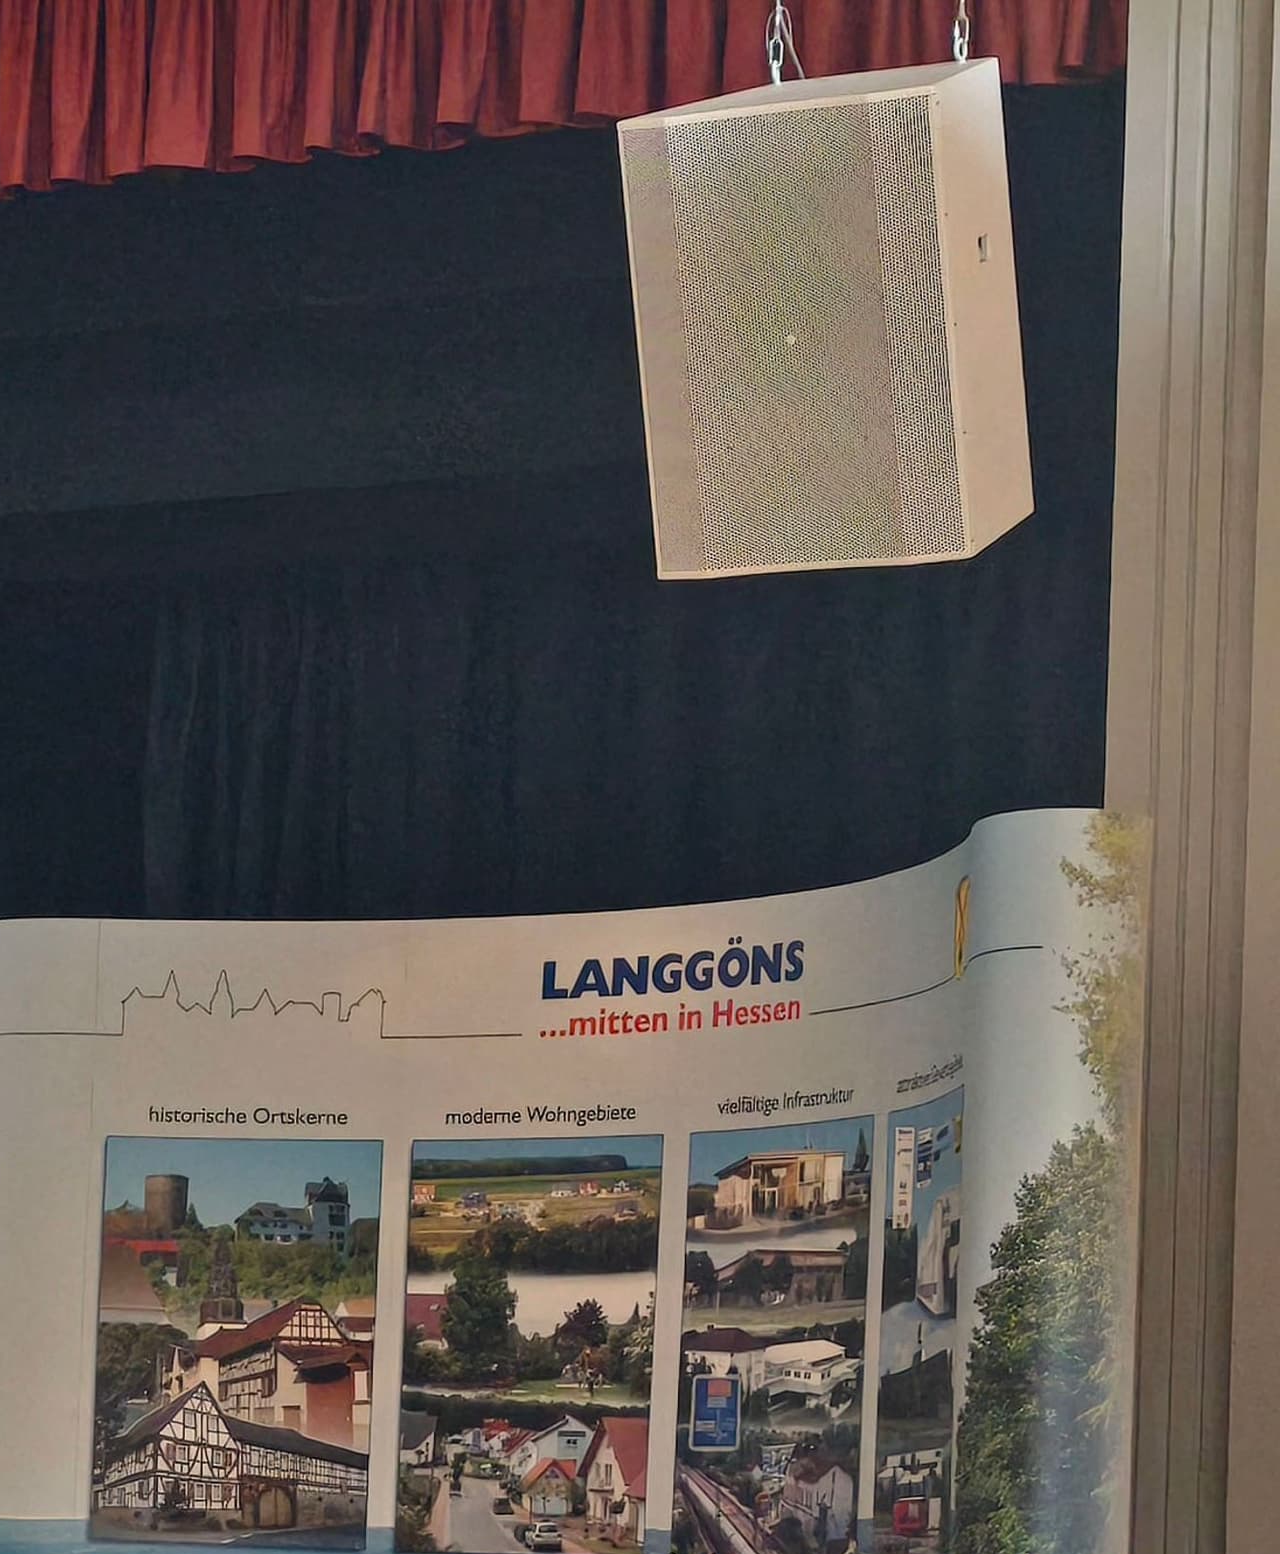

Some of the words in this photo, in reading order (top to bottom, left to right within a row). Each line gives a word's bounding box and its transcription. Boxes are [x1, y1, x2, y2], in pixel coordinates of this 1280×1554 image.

[541, 936, 805, 1000] LANGGÖNS
[539, 1008, 668, 1038] ...mitten
[678, 1003, 702, 1031] in
[712, 999, 801, 1028] Hessen
[148, 1106, 247, 1125] historische
[252, 1107, 348, 1126] Ortskerne
[445, 1108, 522, 1125] moderne
[527, 1104, 637, 1127] Wohngebiete
[717, 1095, 780, 1117] vielfältige
[783, 1088, 854, 1110] Infrastruktur
